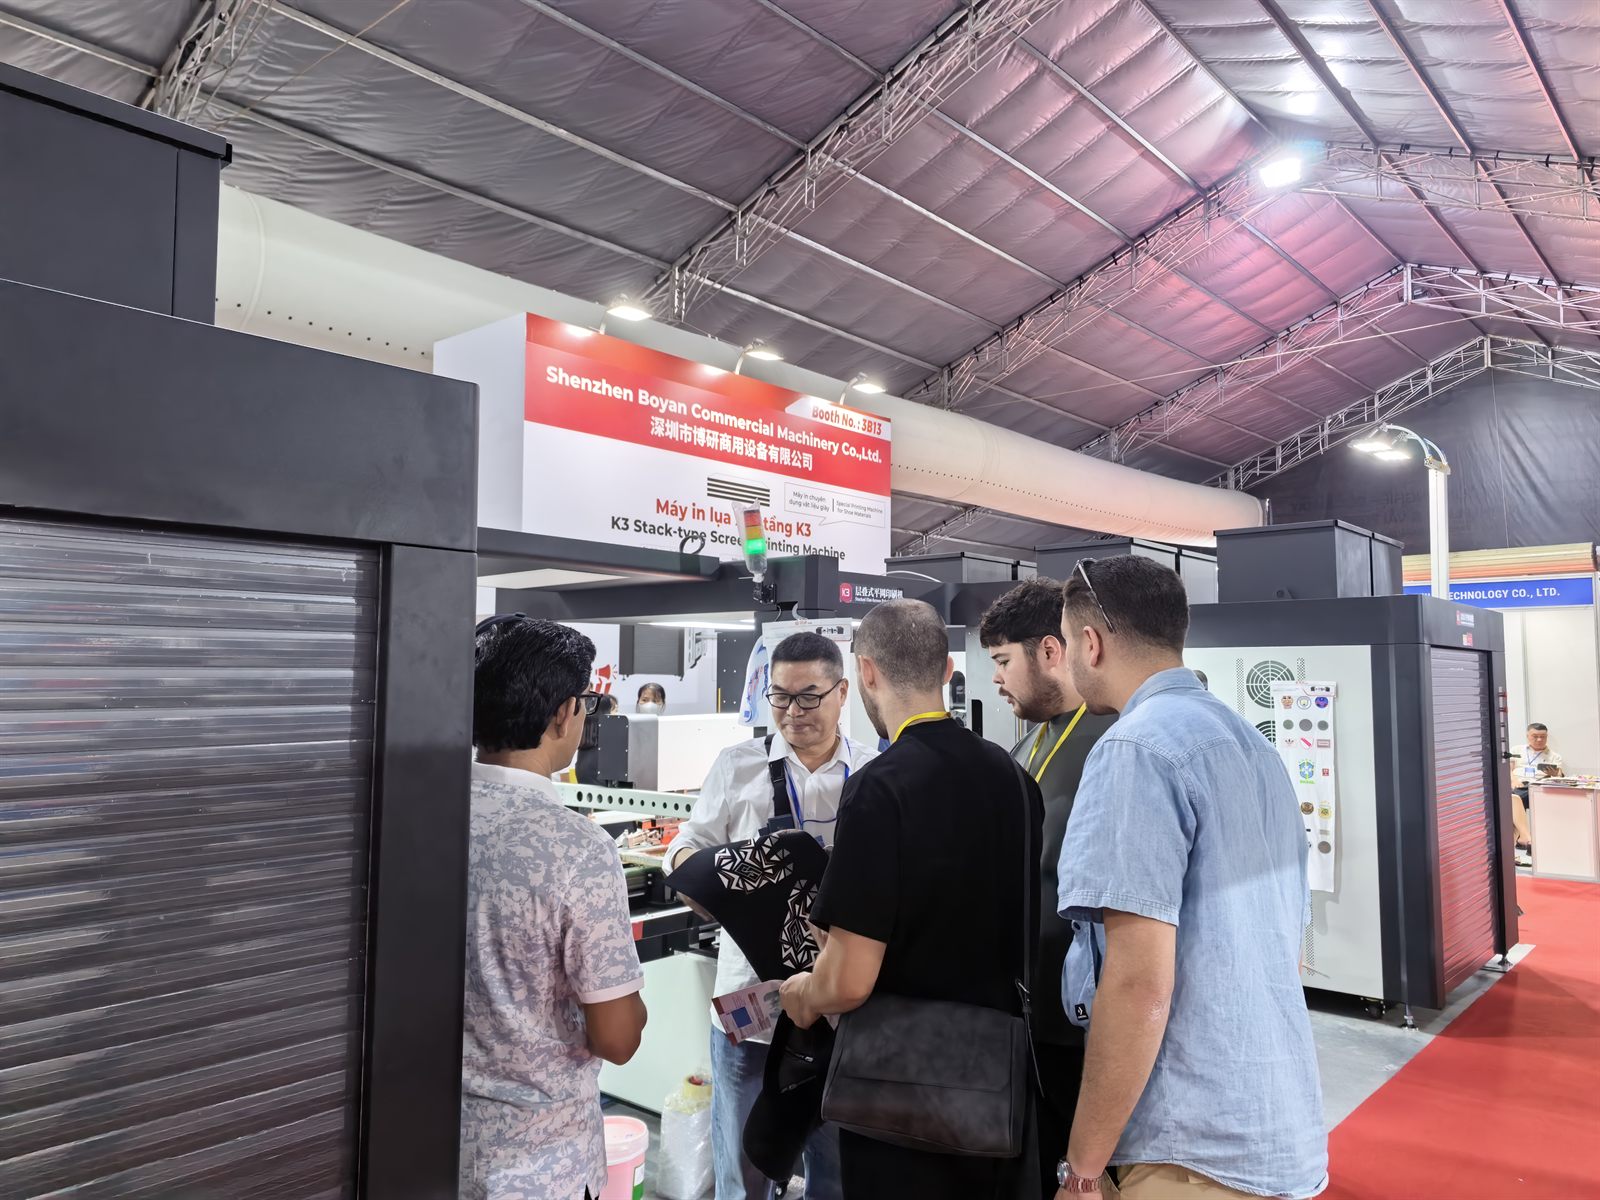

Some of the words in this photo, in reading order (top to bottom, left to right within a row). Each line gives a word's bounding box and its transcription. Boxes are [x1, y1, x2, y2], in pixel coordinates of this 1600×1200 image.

[546, 366, 634, 402] Shenzhen
[638, 388, 687, 415] Boyan
[691, 403, 774, 437] Commercial
[777, 425, 840, 456] Machinery
[841, 443, 882, 464] Co.,Ltd.
[811, 405, 840, 423] Booth
[861, 419, 882, 436] 3B13
[650, 416, 813, 472] 深圳市博研商用设备有限公司
[656, 498, 688, 521] Máy
[692, 502, 706, 521] in
[710, 507, 731, 527] lụa
[867, 506, 883, 514] Machine
[611, 516, 630, 531] K3
[633, 519, 707, 543] Stack-type
[710, 530, 742, 547] Scree
[765, 537, 800, 556] inting
[803, 543, 846, 560] Machine
[763, 515, 793, 537] tầng
[796, 521, 812, 537] K3
[1449, 588, 1508, 600] ECHNOLOGY
[1512, 588, 1533, 599] CO.,
[1536, 587, 1561, 597] LTD.
